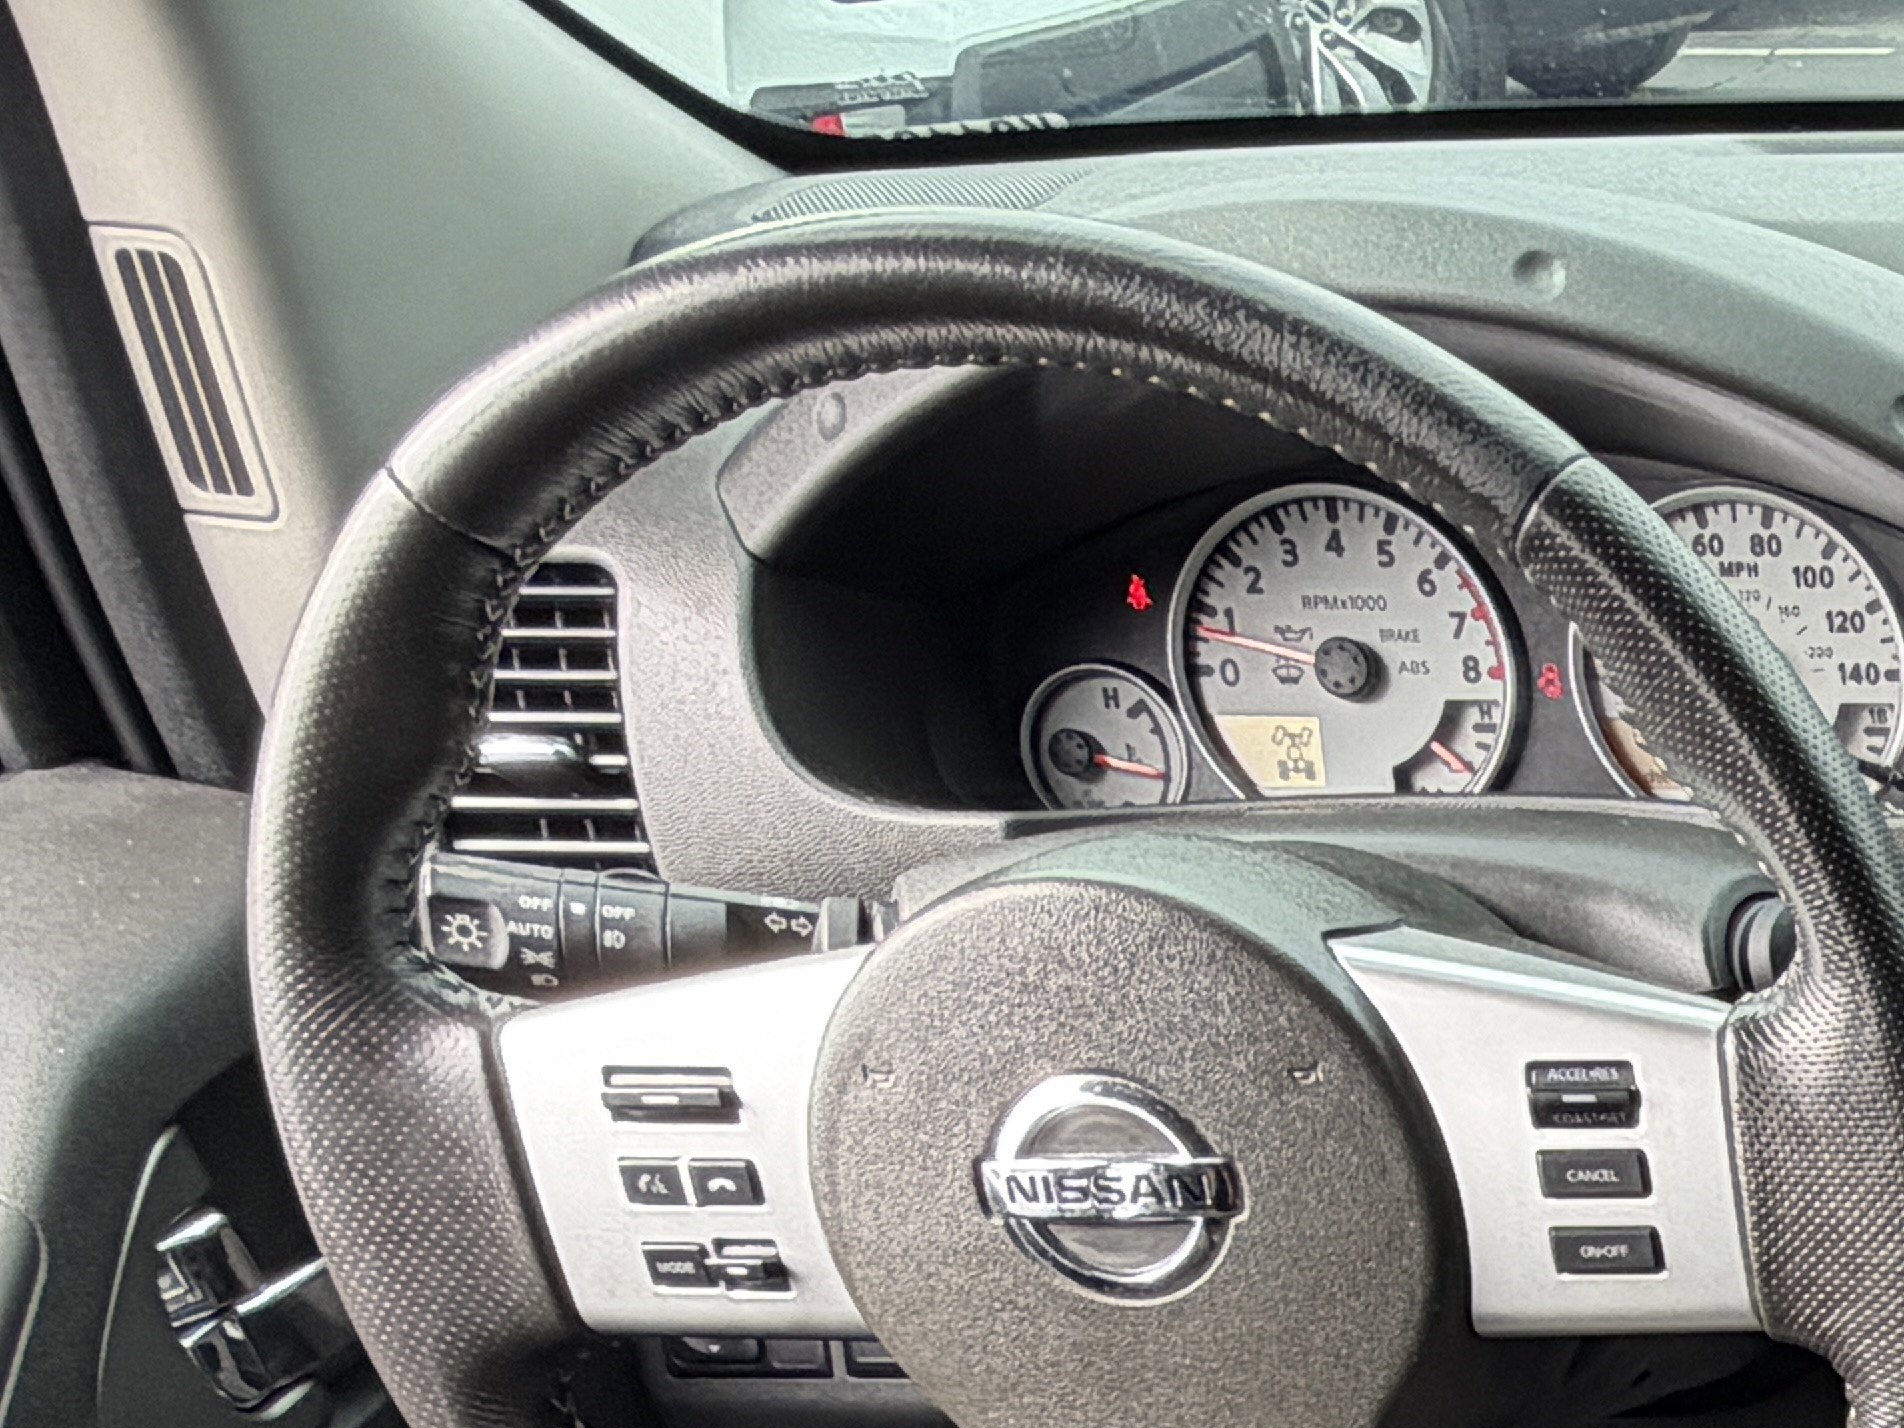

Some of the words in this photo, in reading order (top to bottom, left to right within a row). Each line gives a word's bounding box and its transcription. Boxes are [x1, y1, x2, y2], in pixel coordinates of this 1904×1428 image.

[1280, 539, 1300, 567] 3
[1325, 529, 1345, 557] 4
[1377, 540, 1395, 567] 5
[1692, 533, 1724, 557] 60
[1750, 533, 1782, 557] 80
[1243, 566, 1264, 594] 2
[1718, 561, 1759, 578] MPH
[1792, 565, 1835, 589] 100
[1417, 569, 1437, 597] 6
[1449, 611, 1467, 639] 7
[1825, 610, 1866, 634] 120
[1220, 658, 1239, 686] 0
[1462, 655, 1481, 684] 8
[1838, 662, 1880, 686] 140
[1103, 687, 1121, 708] H
[518, 895, 554, 912] OFF
[602, 904, 636, 921] OFF
[507, 921, 555, 940] AUTO
[1566, 1169, 1620, 1183] CANCEL
[1005, 1174, 1213, 1207] NISSAN
